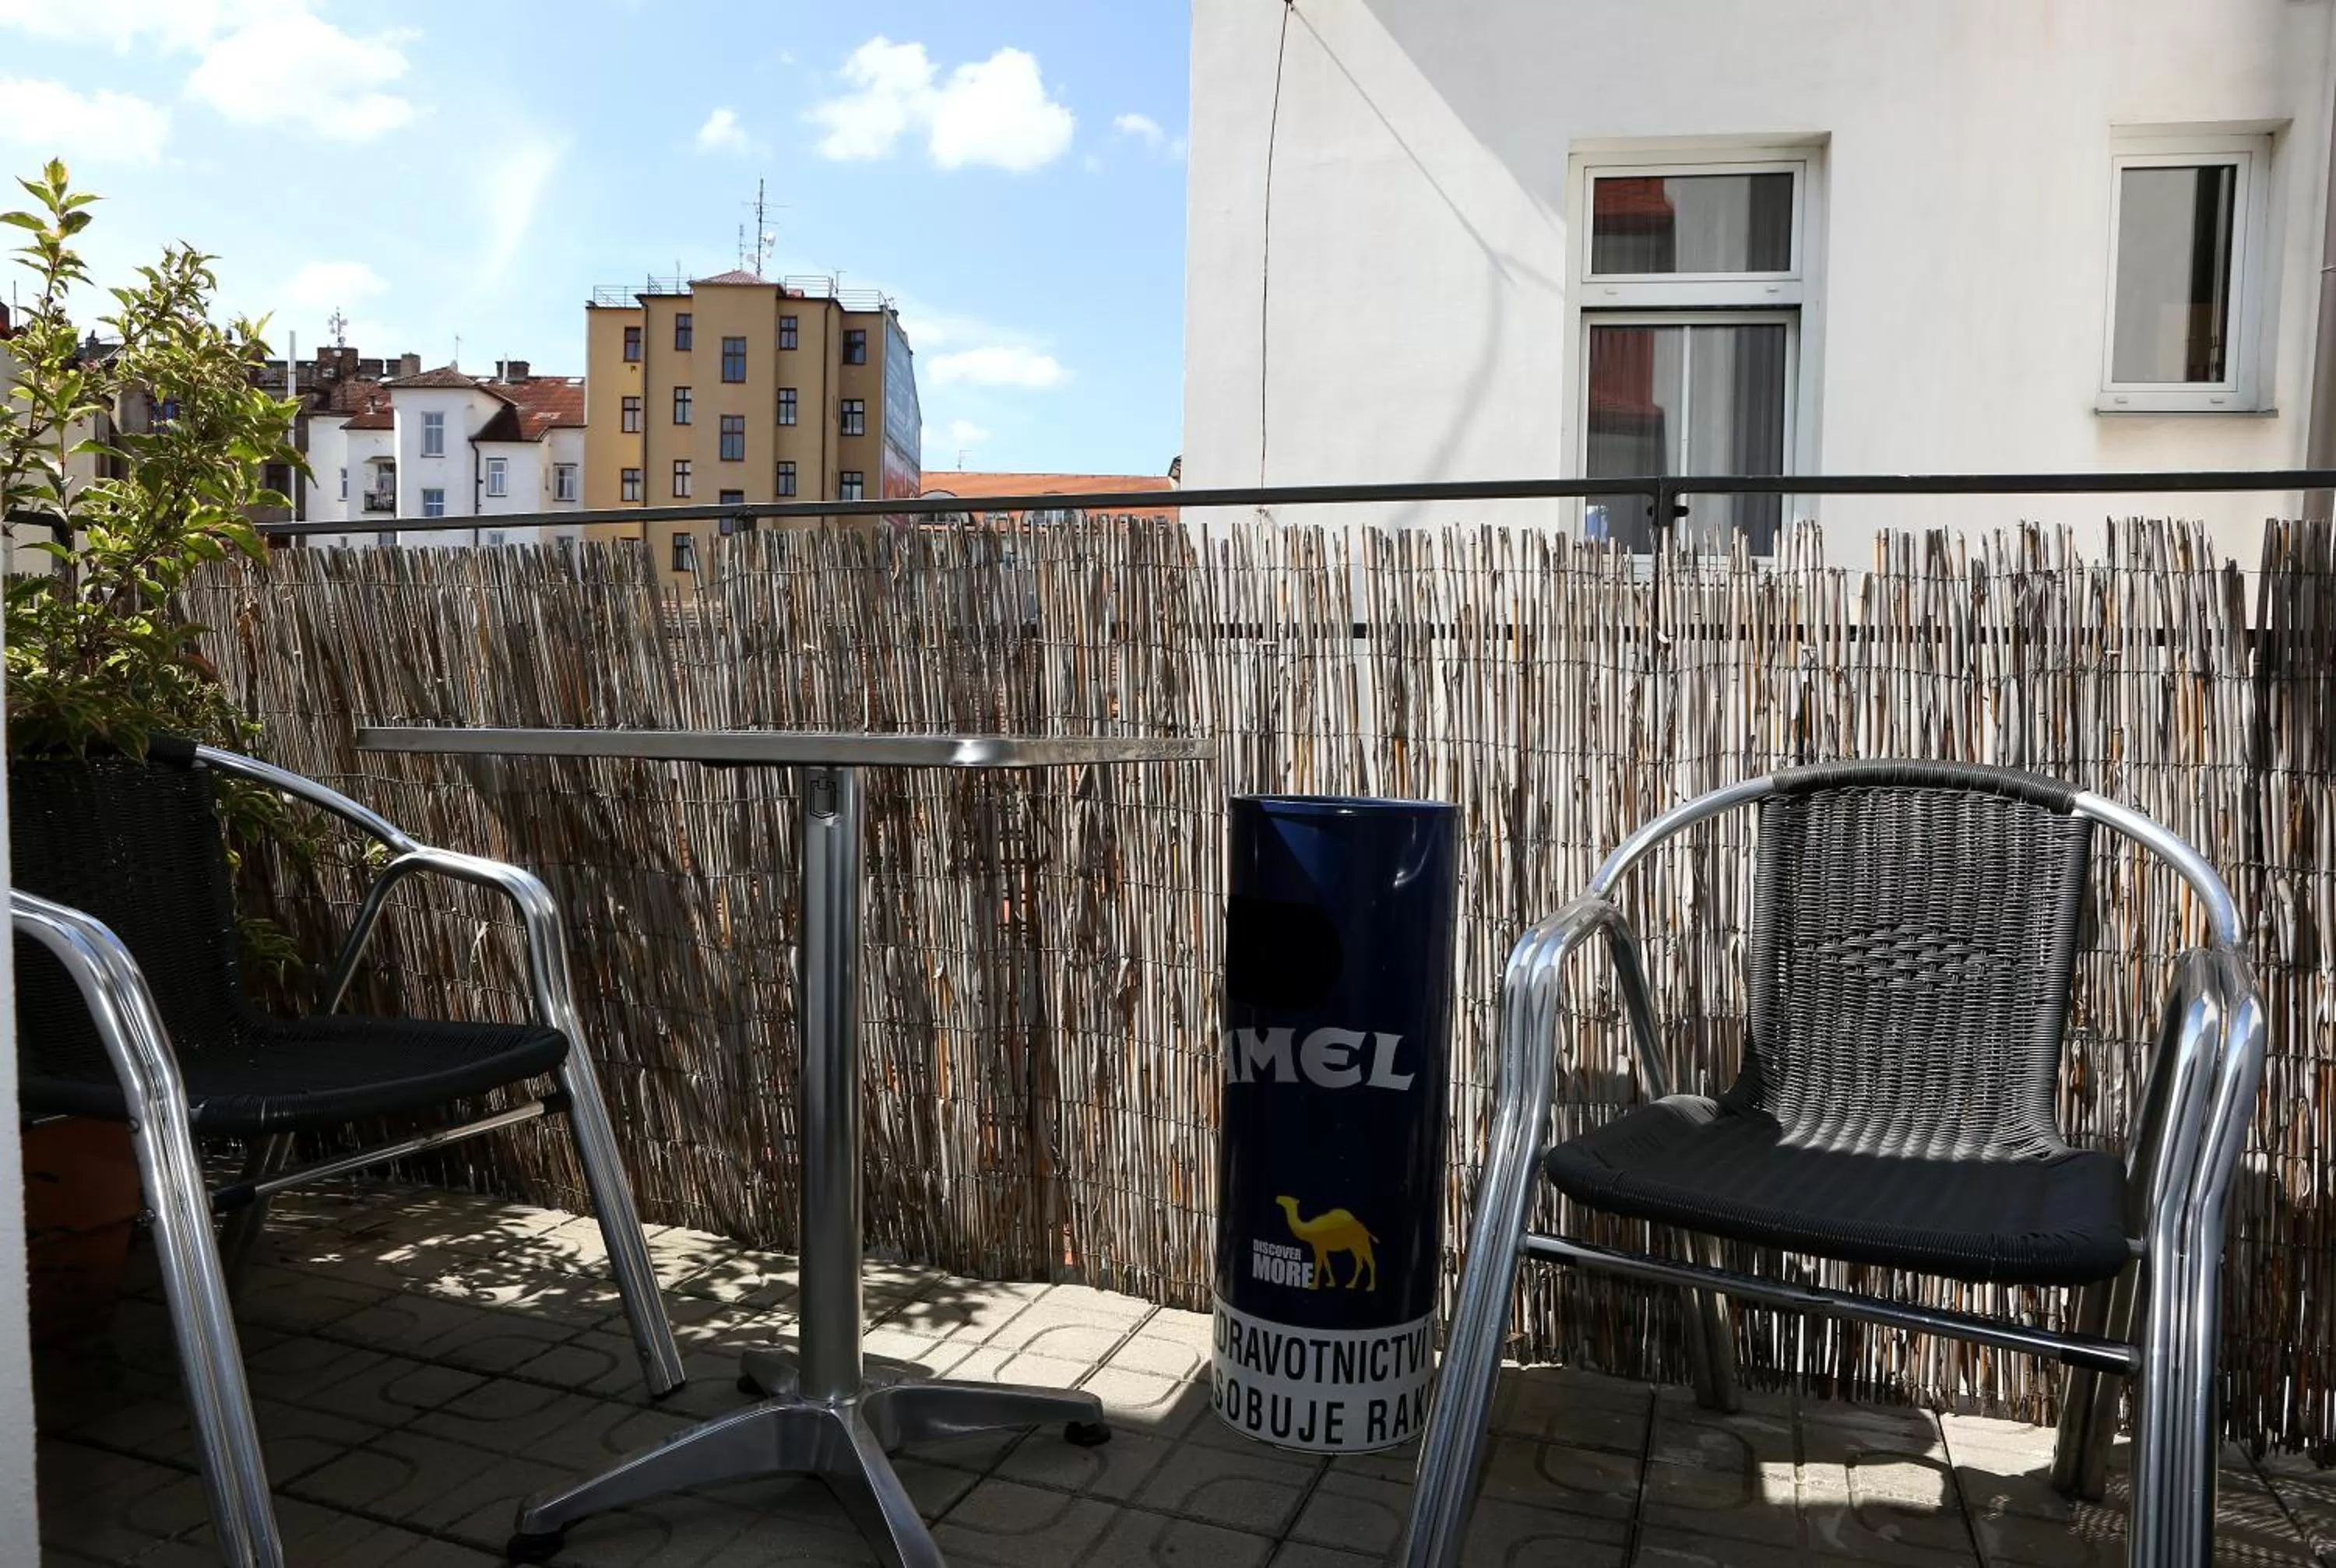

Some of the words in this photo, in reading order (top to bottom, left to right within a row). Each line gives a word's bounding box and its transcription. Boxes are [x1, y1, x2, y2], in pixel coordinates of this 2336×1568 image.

[1252, 1252, 1314, 1289] MORE
[1253, 1239, 1301, 1260] DISCOVER
[1213, 1305, 1427, 1384] DRAVOTNICTVÍ
[1211, 1367, 1346, 1444] SOBUJE
